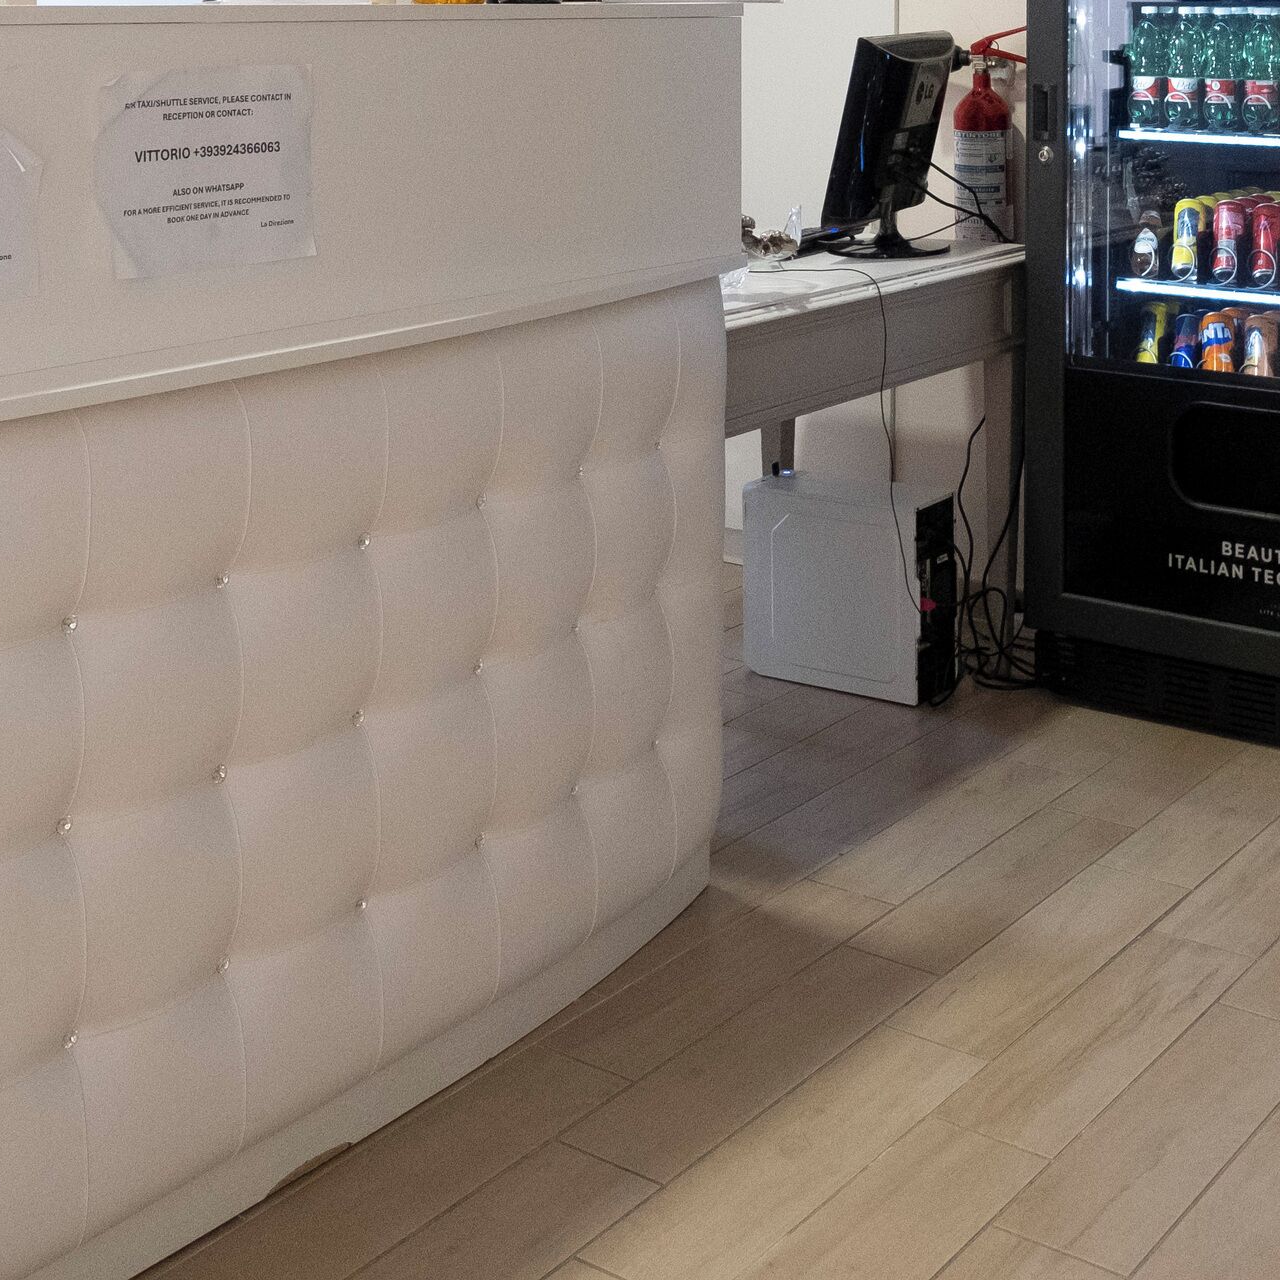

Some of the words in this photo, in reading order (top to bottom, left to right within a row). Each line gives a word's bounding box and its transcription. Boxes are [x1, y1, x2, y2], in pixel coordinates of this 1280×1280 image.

[924, 83, 934, 99] LG
[137, 98, 188, 109] TAXI/SHUTTLE
[189, 96, 221, 106] SERVICE,
[222, 94, 249, 103] PLEASE
[250, 94, 283, 102] CONTACT
[163, 111, 204, 121] RECEPTION
[205, 110, 215, 118] OR
[216, 109, 253, 118] CONTACT:
[135, 147, 191, 163] VITTORIO
[193, 141, 280, 158] +393924366063
[173, 187, 191, 197] ALSO
[192, 186, 204, 195] ON
[204, 183, 244, 193] WHATSAPP
[143, 206, 161, 214] MORE
[162, 203, 192, 213] EFFICIENT
[193, 200, 220, 210] SERVICE,
[234, 194, 282, 205] RECOMMENDED
[167, 216, 185, 224] BOOK
[186, 214, 199, 222] ONE
[220, 209, 249, 218] ADVANCE
[268, 219, 294, 227] Direzione
[1168, 553, 1244, 580] ITALIAN
